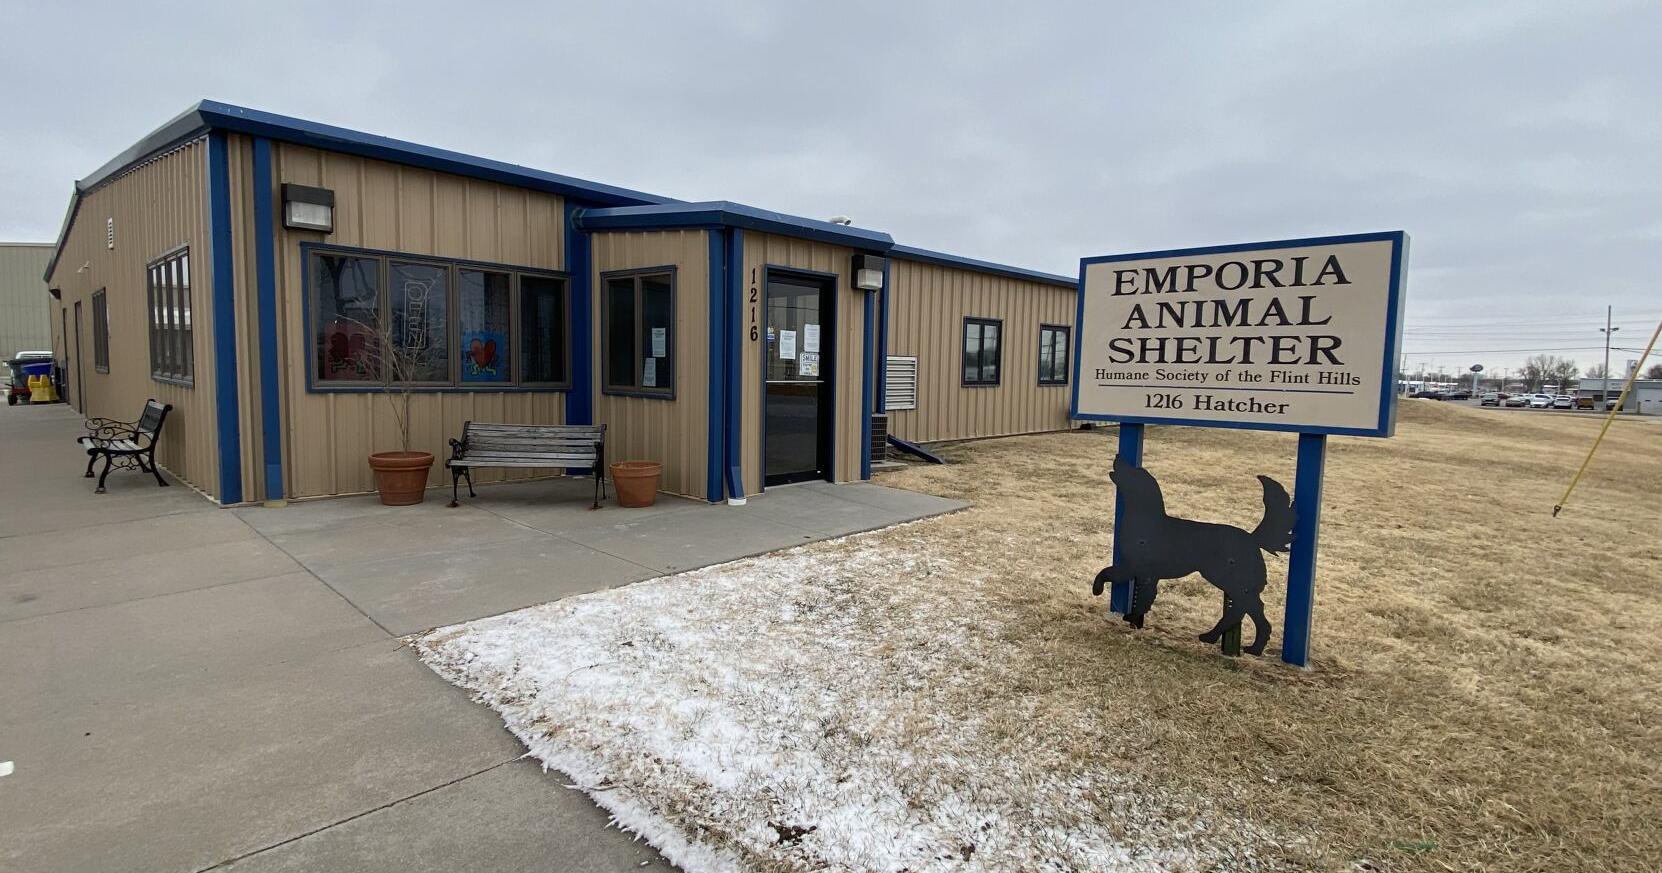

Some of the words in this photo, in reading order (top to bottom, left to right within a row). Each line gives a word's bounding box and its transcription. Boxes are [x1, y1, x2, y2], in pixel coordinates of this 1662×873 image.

[1111, 254, 1351, 297] EMPORIA
[749, 267, 758, 342] 1216
[1121, 295, 1333, 330] ANIMAL
[1108, 335, 1344, 365] SHELTER
[1095, 368, 1149, 380] Humane
[1156, 368, 1208, 383] Society
[1215, 370, 1231, 382] of
[1238, 370, 1262, 383] the
[1270, 371, 1310, 384] Flint
[1318, 371, 1361, 386] Hills
[1145, 394, 1183, 409] 1216
[1193, 394, 1290, 414] Hatcher
